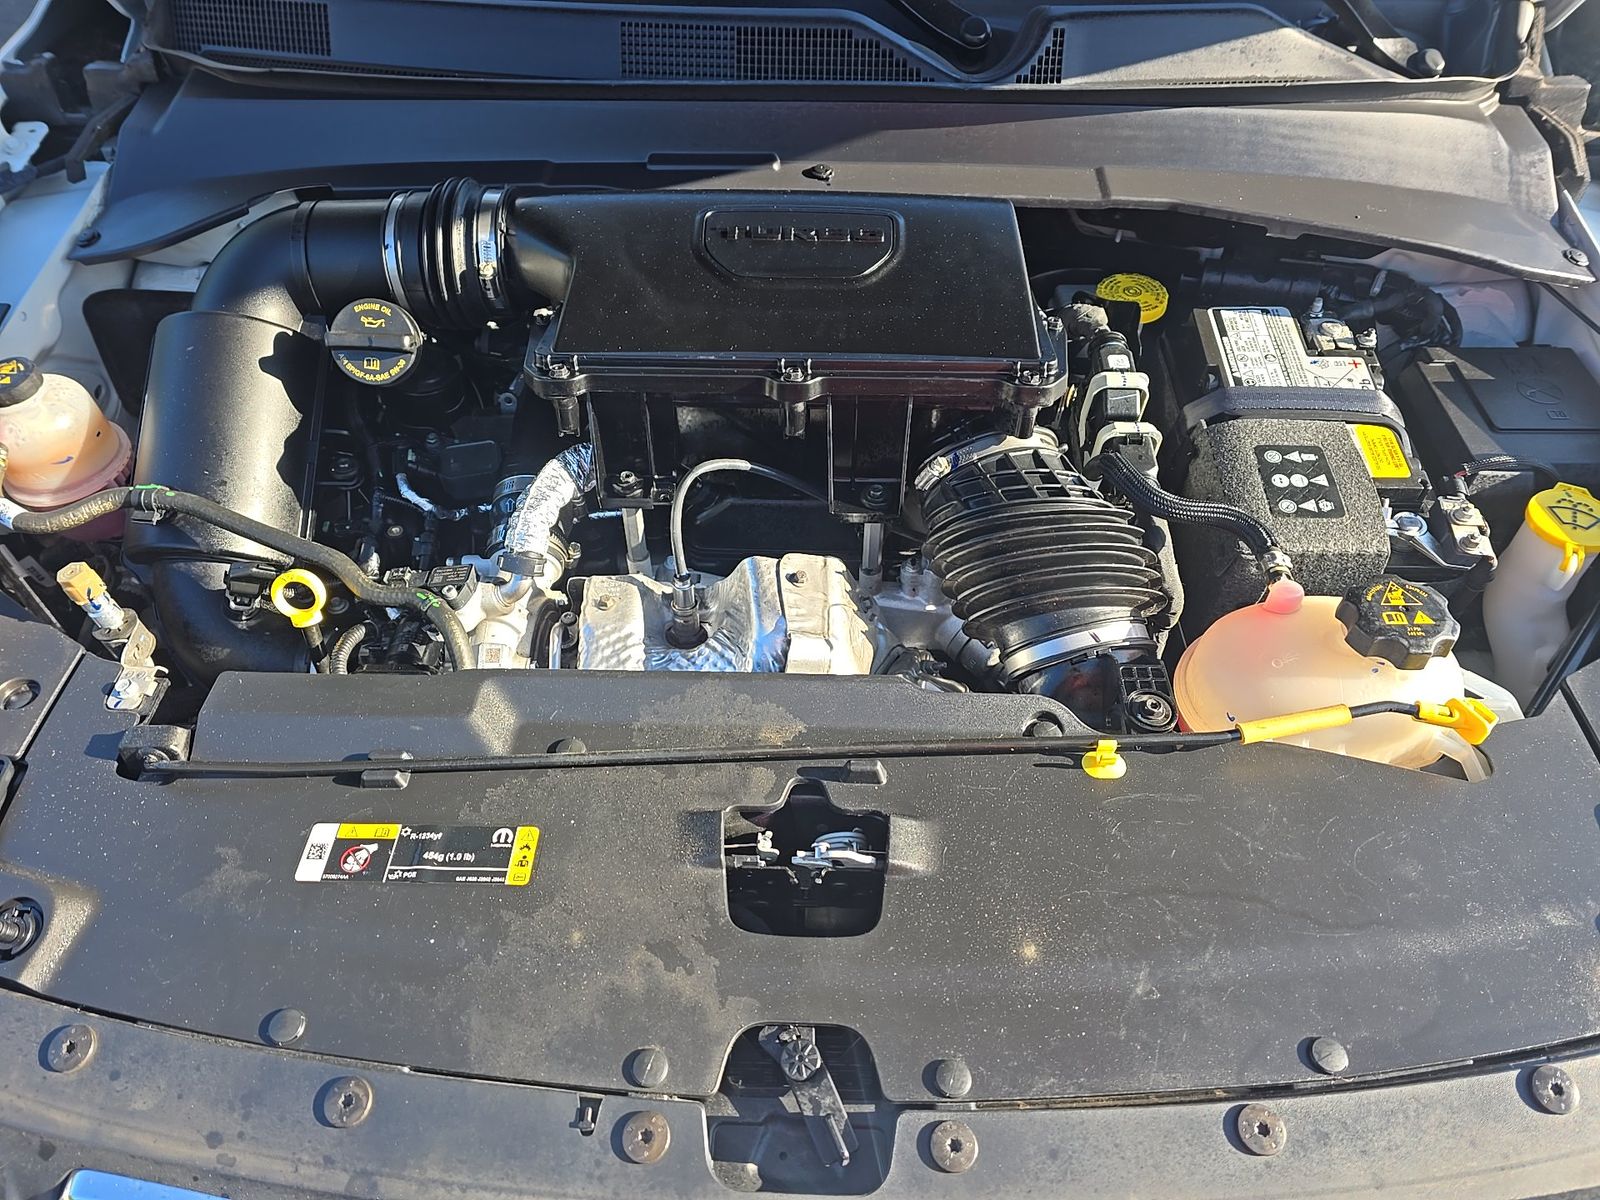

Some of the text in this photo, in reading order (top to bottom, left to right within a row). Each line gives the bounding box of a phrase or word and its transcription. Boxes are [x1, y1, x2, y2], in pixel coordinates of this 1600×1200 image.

[354, 302, 392, 316] ENGINE OIL
[410, 831, 443, 841] R-1234yf
[422, 851, 475, 863] 454g (1.0 lb)
